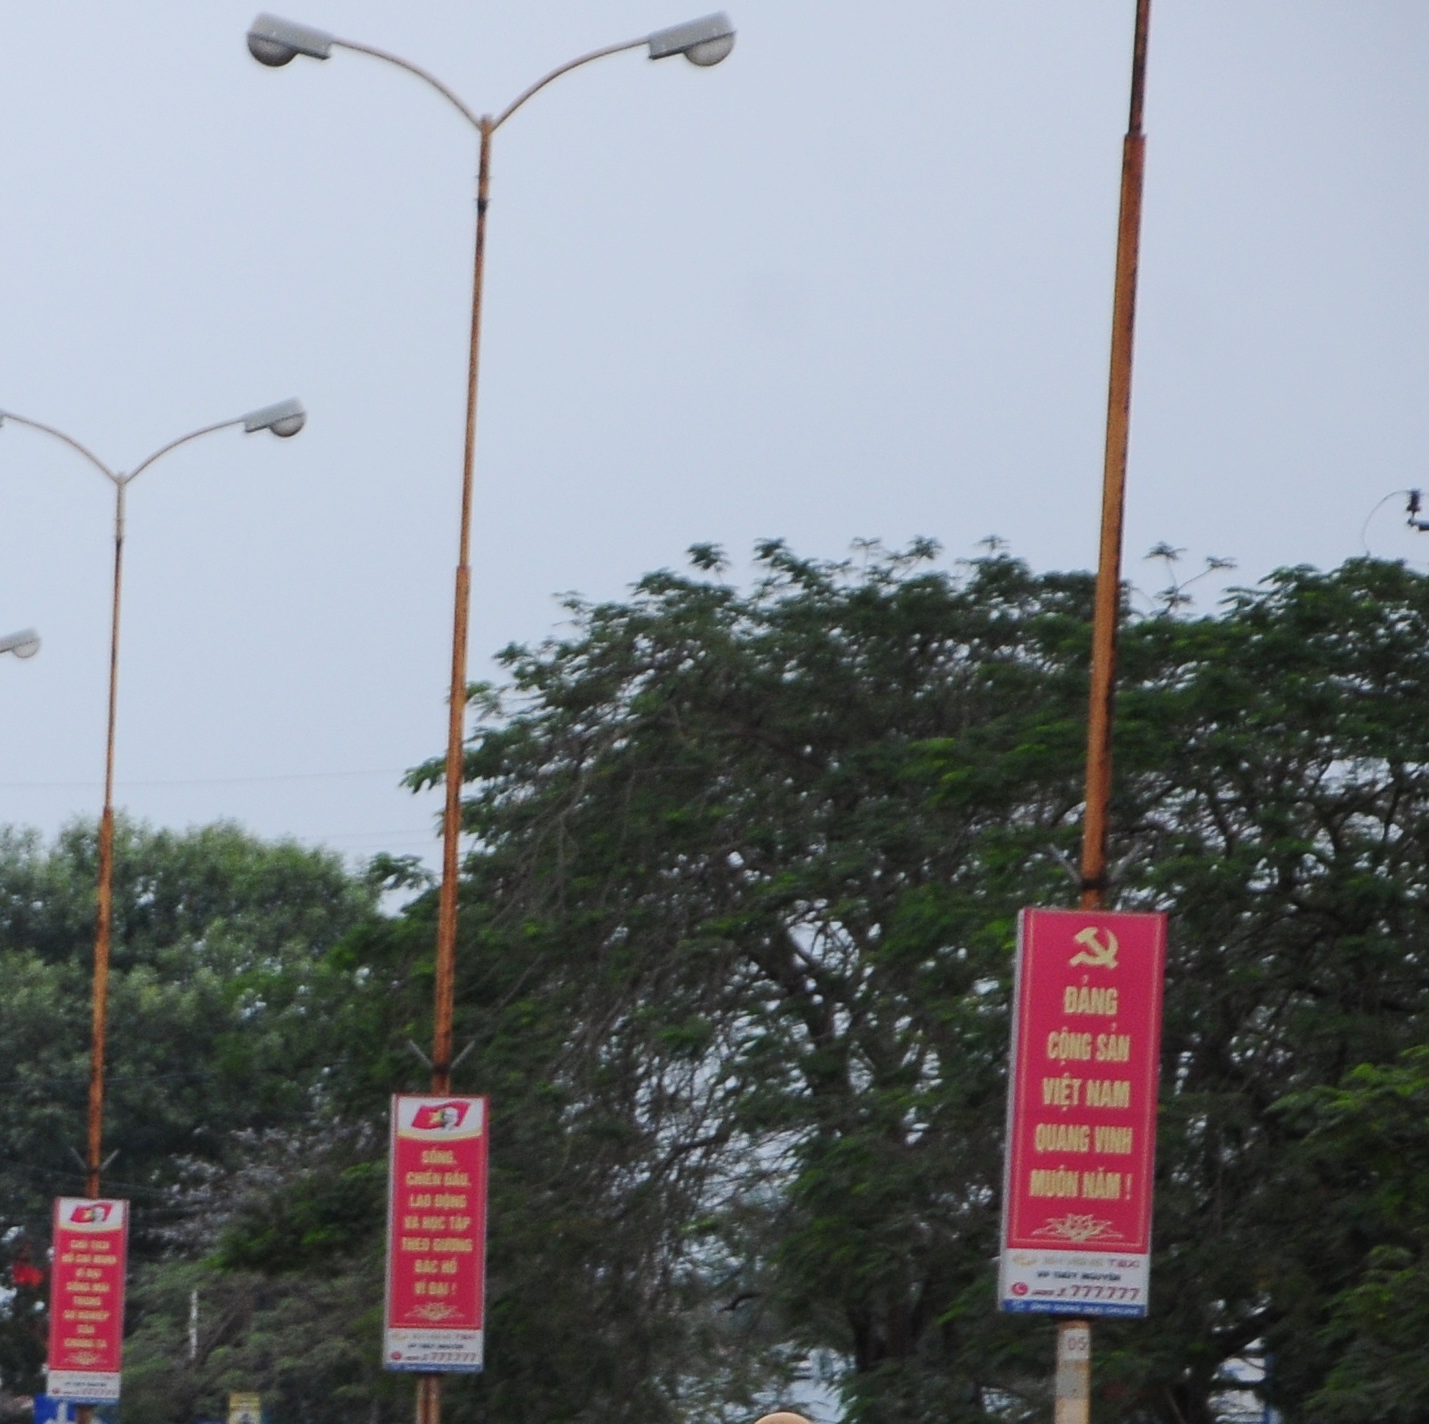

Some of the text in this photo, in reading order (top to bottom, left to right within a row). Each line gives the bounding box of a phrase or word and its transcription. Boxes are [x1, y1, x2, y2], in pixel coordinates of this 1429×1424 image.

[1064, 974, 1118, 1016] ĐẢNG
[1047, 1022, 1131, 1066] CỘNG SẢN
[1042, 1072, 1131, 1112] VIỆT NAM
[1034, 1123, 1133, 1154] QUANG VINH
[1028, 1164, 1079, 1198] MUÔN
